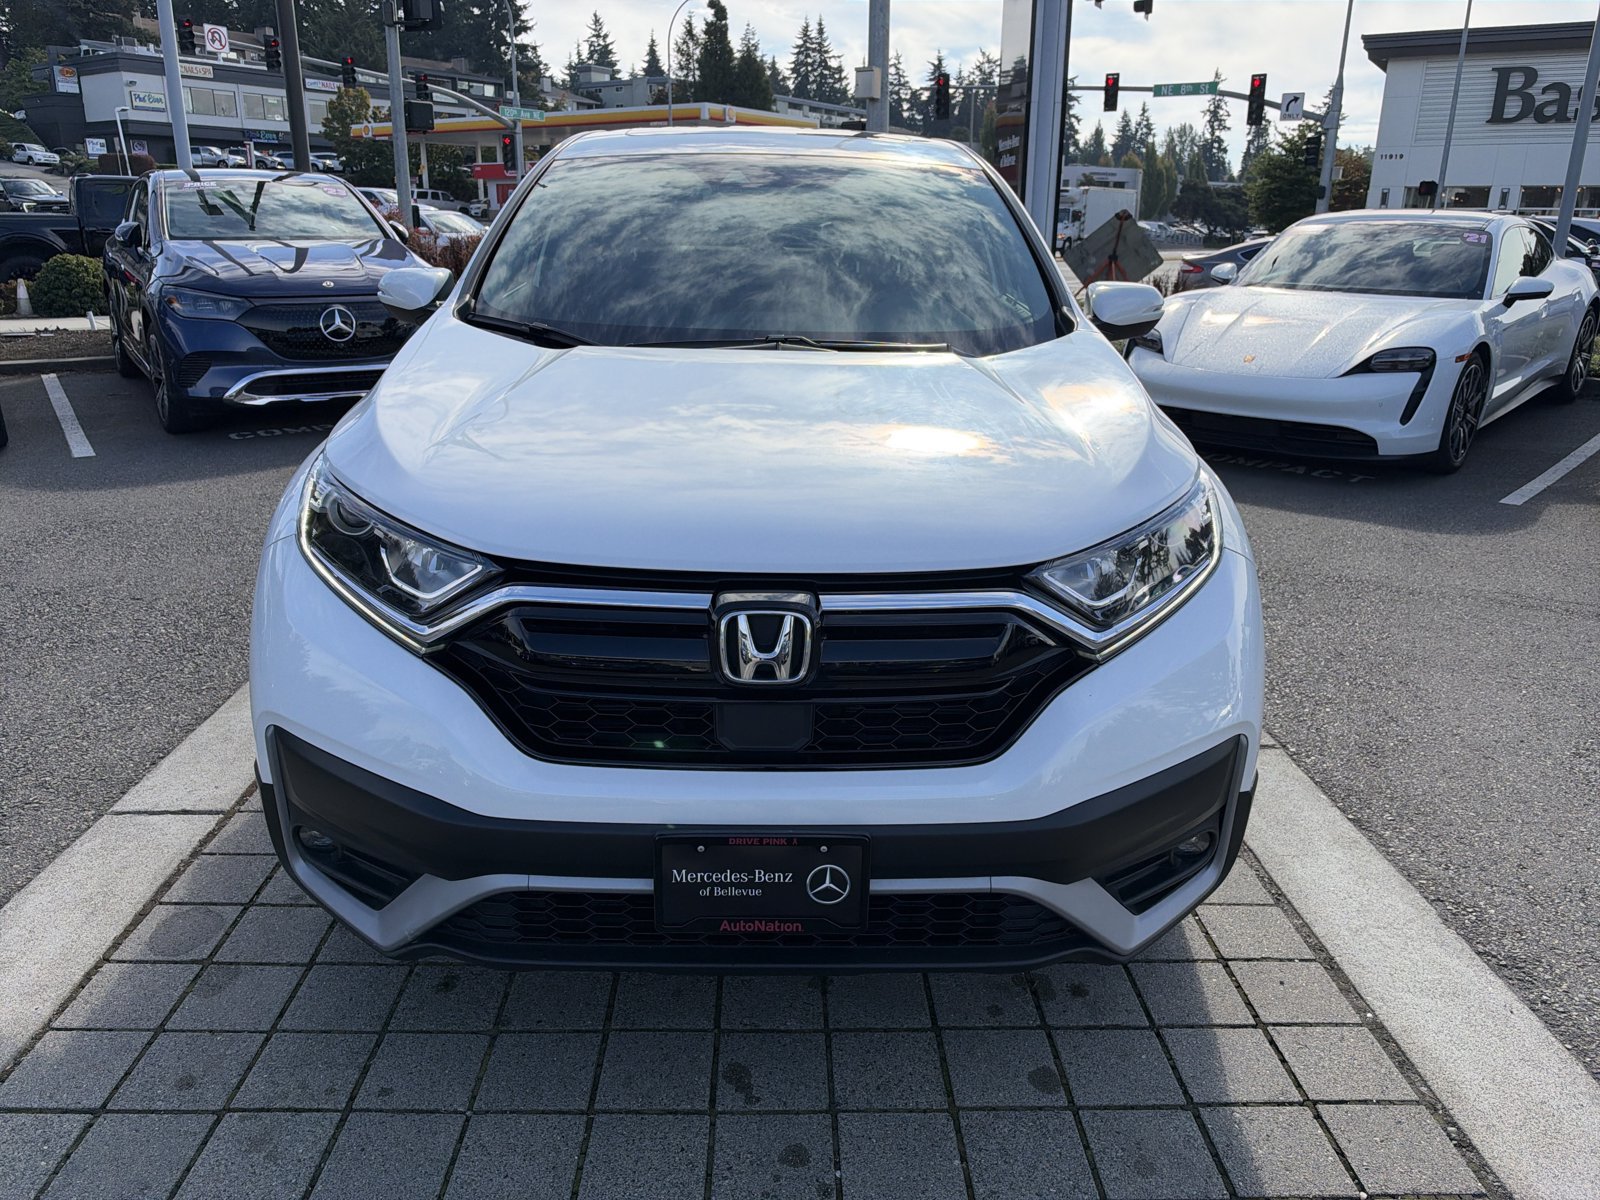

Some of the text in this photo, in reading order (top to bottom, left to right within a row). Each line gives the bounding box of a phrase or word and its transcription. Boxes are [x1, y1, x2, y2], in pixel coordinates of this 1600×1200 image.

[1160, 83, 1210, 96] NE 8th St
[228, 424, 334, 440] COMP
[1203, 452, 1377, 483] OMPACT
[728, 837, 788, 846] DRIVE PINK
[671, 869, 793, 883] Mercedes-Benz
[699, 886, 762, 897] of Bellevue
[719, 919, 802, 932] AutoNation
